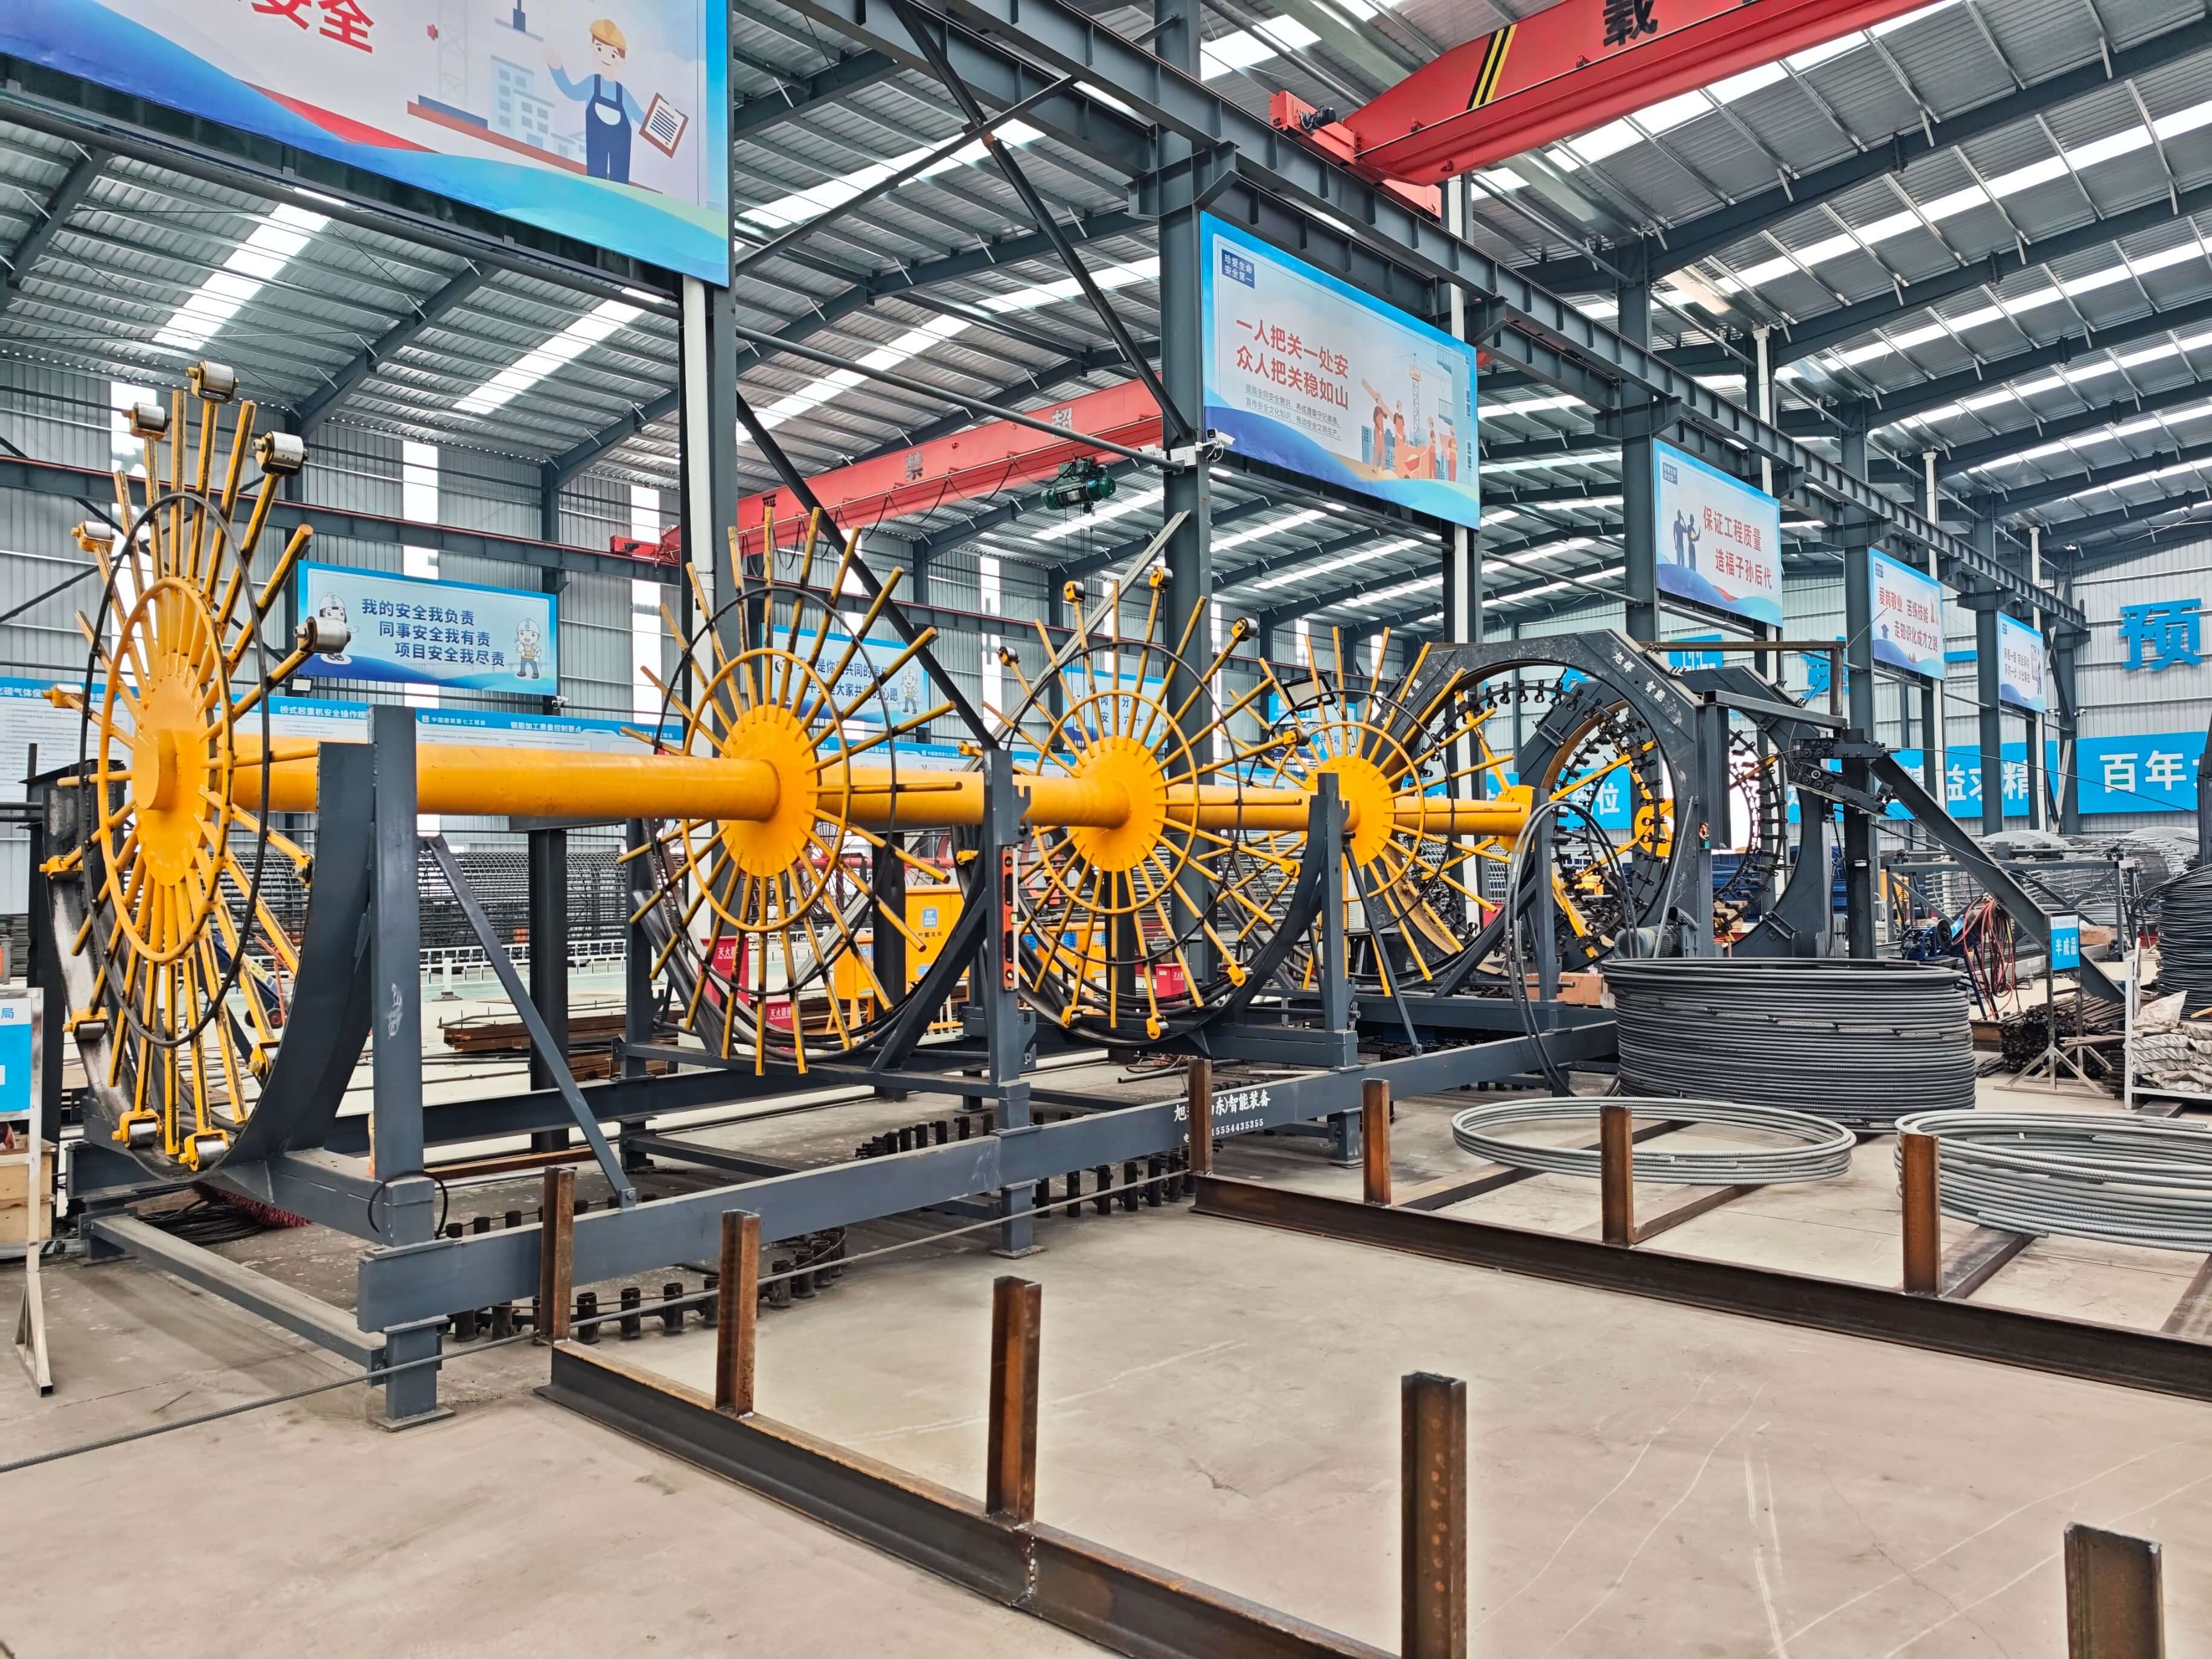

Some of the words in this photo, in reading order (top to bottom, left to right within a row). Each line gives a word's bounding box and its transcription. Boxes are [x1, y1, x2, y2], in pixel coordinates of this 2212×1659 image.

[1224, 266, 1253, 282] 安全第一
[1236, 319, 1349, 379] 一人把关一处安
[1236, 345, 1349, 411] 众人把关稳如山
[1704, 505, 1762, 552] 保证工程质量
[1715, 548, 1772, 590] 造福子孙后代
[362, 598, 475, 626] 我的安全我负责
[1879, 587, 1903, 613] 爱岗敬业
[1907, 599, 1929, 624] 苦练技能
[379, 621, 490, 647] 同事安全我有责
[1894, 620, 1938, 653] 走知识化成才之路
[2118, 598, 2202, 671] 预
[395, 642, 505, 667] 项目安全我尽责
[2099, 750, 2198, 793] 百年
[1, 1008, 14, 1018] 局
